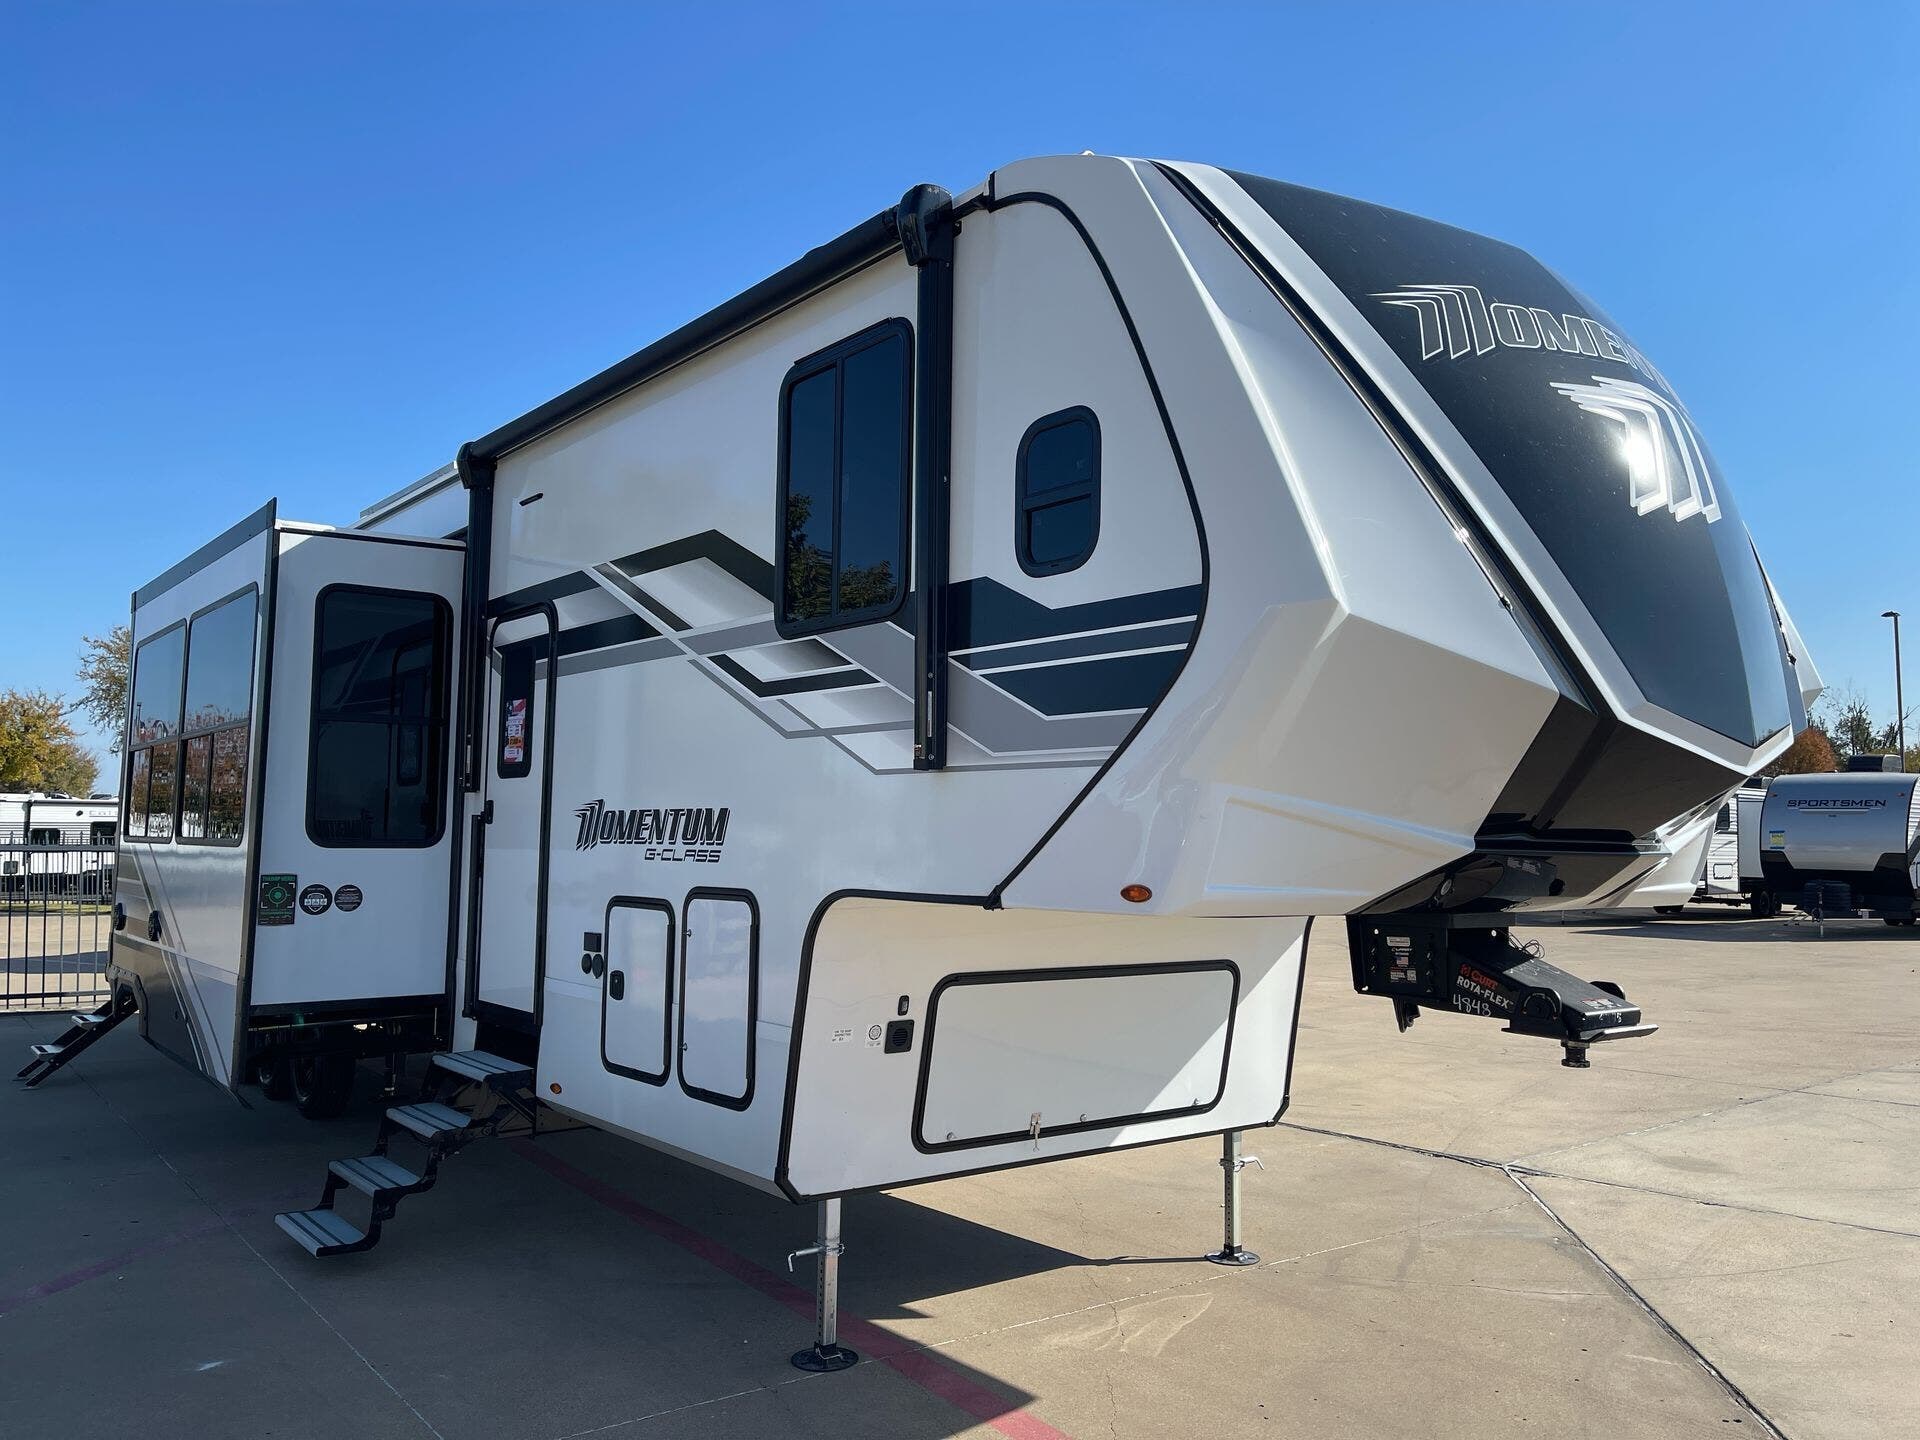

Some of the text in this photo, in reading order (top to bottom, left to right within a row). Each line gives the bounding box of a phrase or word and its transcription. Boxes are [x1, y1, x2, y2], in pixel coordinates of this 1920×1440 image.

[1787, 799, 1886, 807] SPORTSMEN
[573, 799, 730, 850] MOMENTUM
[644, 848, 721, 862] G-CLASS
[1471, 969, 1499, 990] CURT
[1456, 975, 1510, 1009] ROTA-FLEX
[1453, 993, 1492, 1018] 4848
